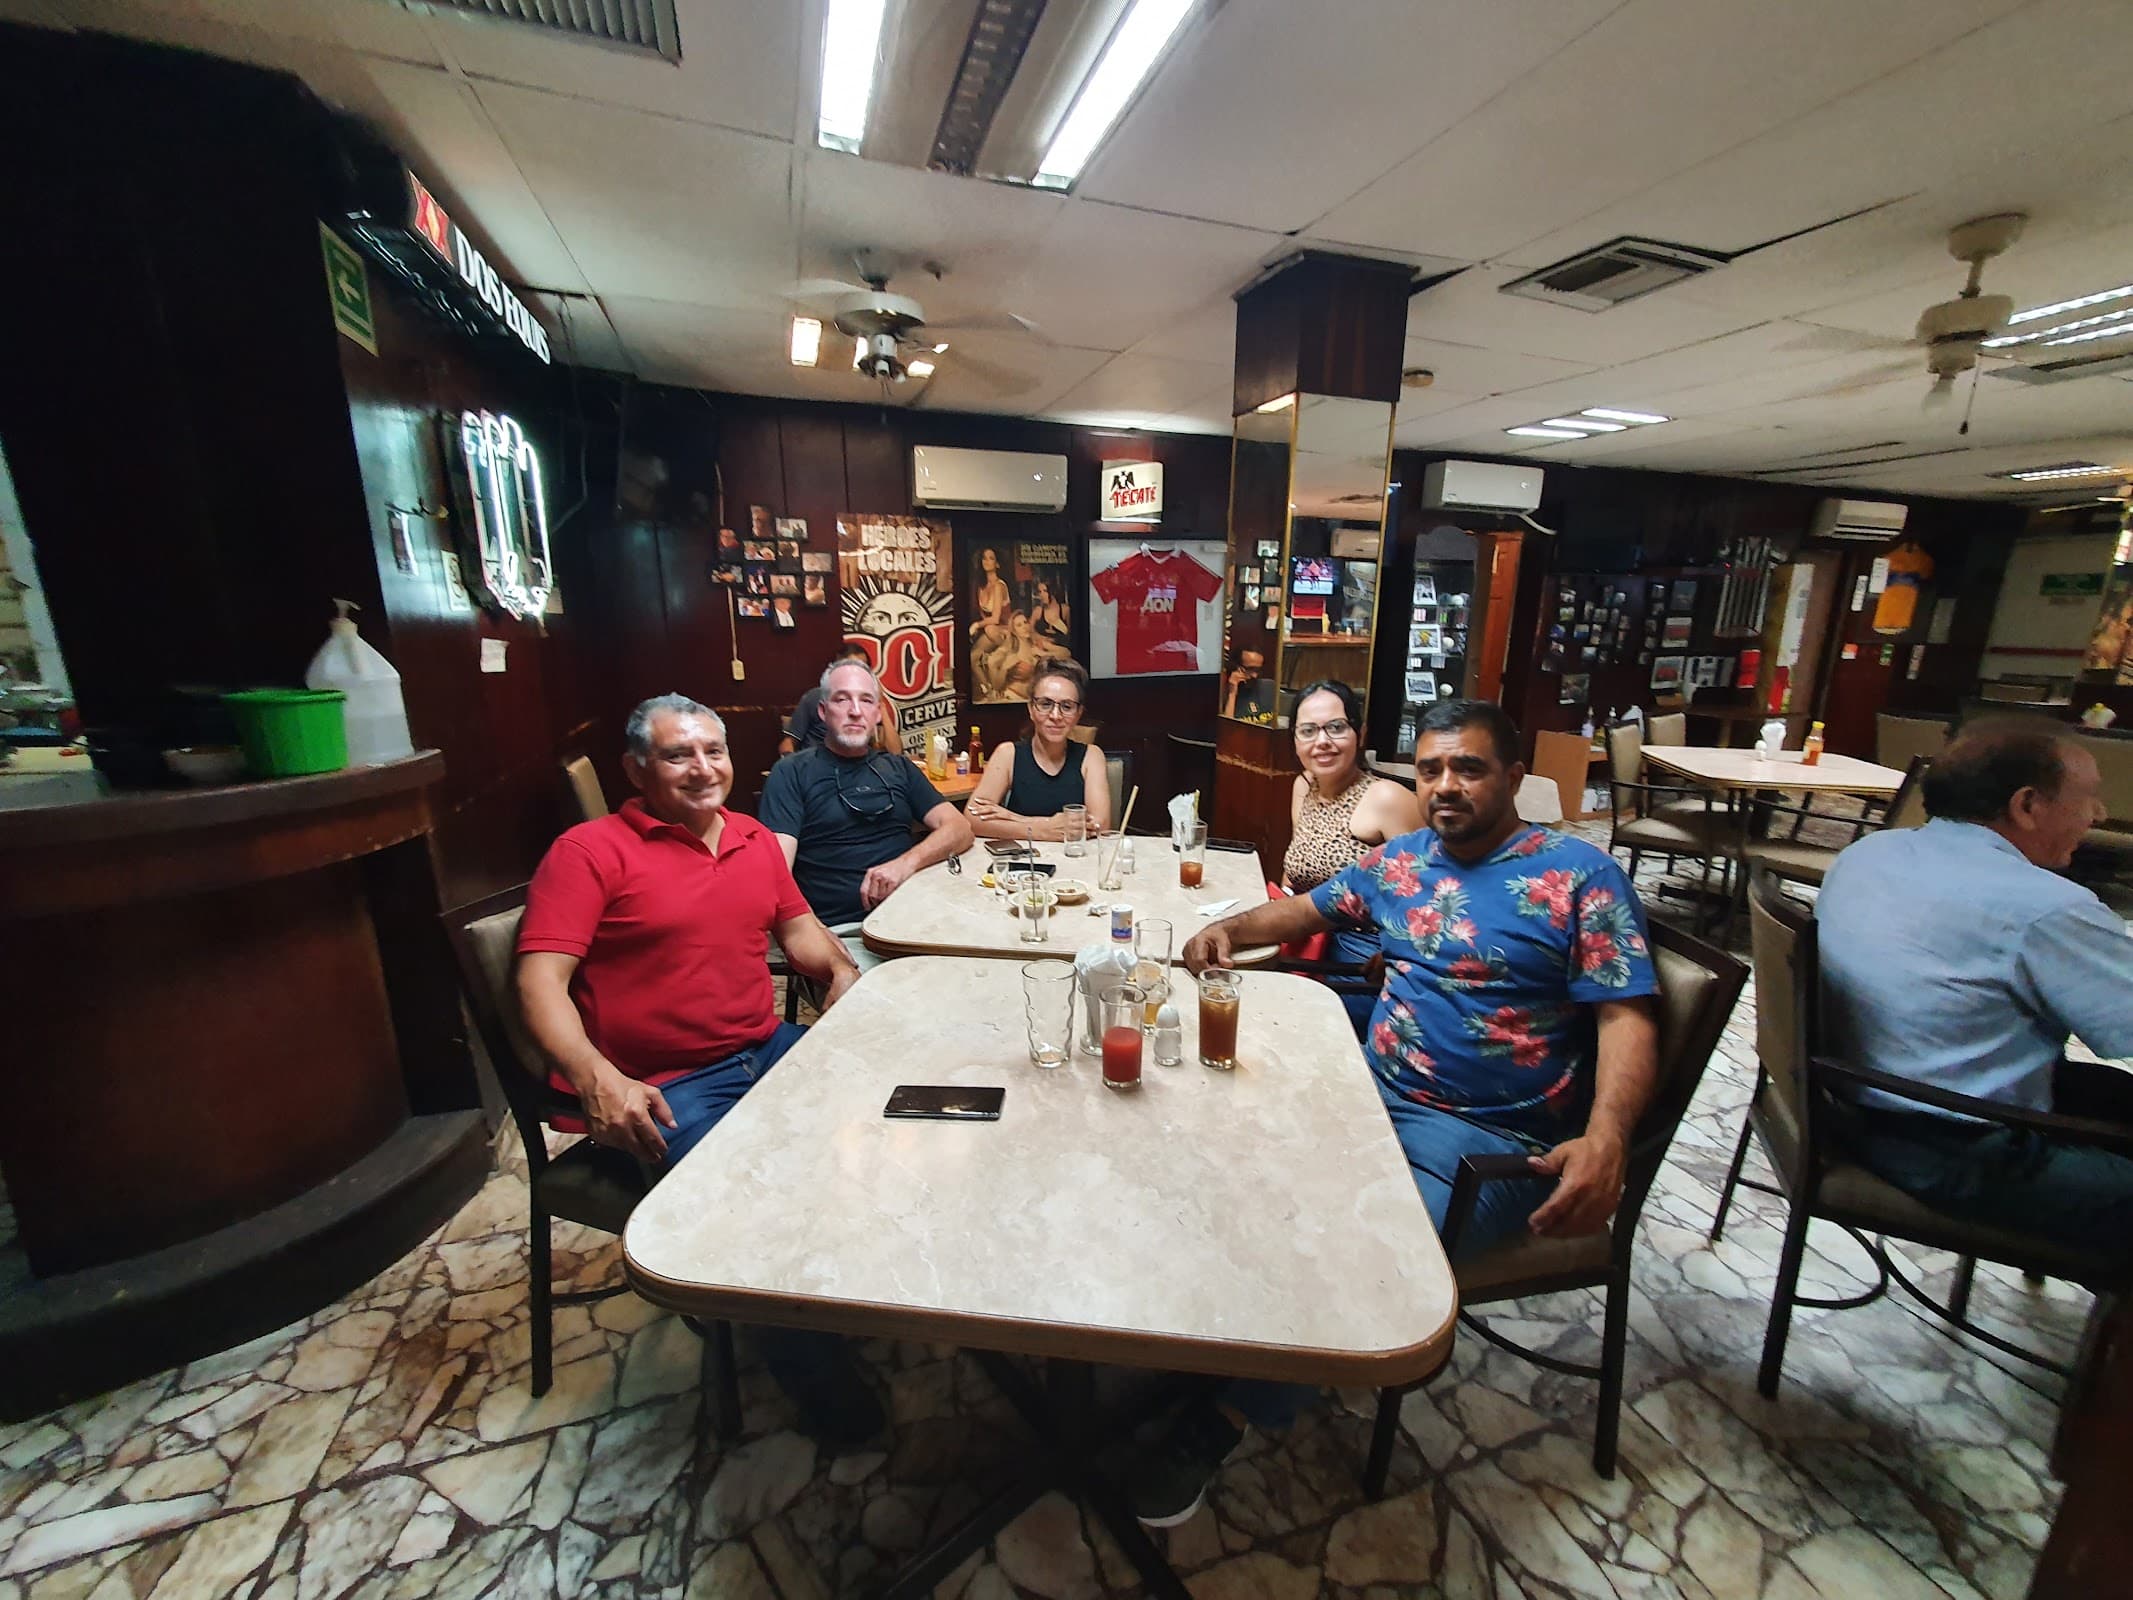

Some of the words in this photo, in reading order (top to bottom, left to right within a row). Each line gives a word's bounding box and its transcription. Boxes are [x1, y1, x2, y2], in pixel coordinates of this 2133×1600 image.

[453, 224, 503, 316] DOS
[500, 281, 551, 365] EQUIS
[1109, 486, 1157, 509] TECATE
[861, 524, 931, 549] HEROES
[857, 549, 937, 573] LOCALES
[1141, 595, 1175, 615] AON
[903, 699, 957, 725] CERVE
